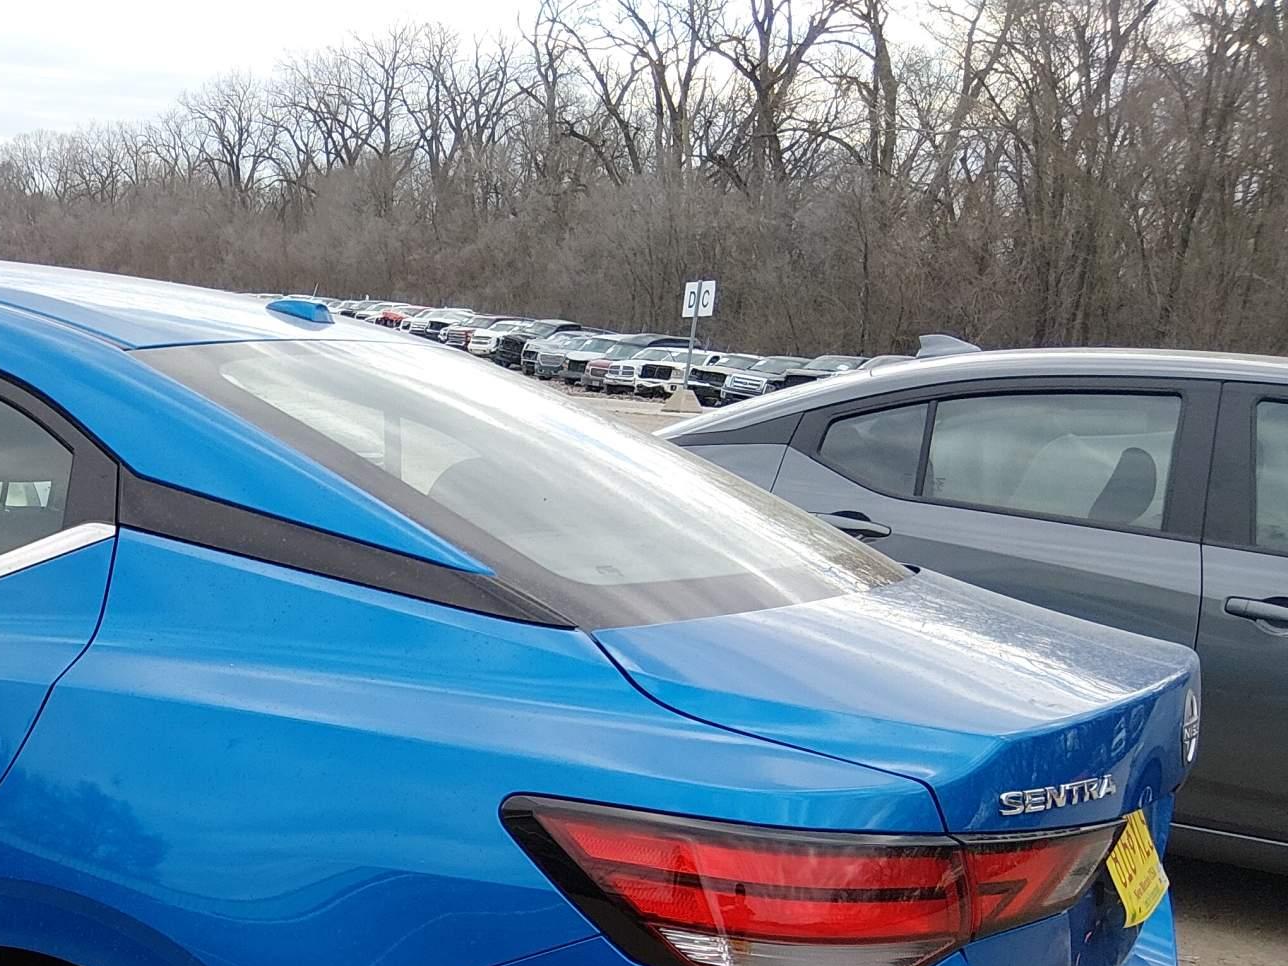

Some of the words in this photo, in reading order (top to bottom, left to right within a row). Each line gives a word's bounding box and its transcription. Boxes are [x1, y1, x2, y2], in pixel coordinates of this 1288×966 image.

[688, 291, 696, 308] D
[702, 290, 710, 308] C
[998, 774, 1117, 817] SENTRA
